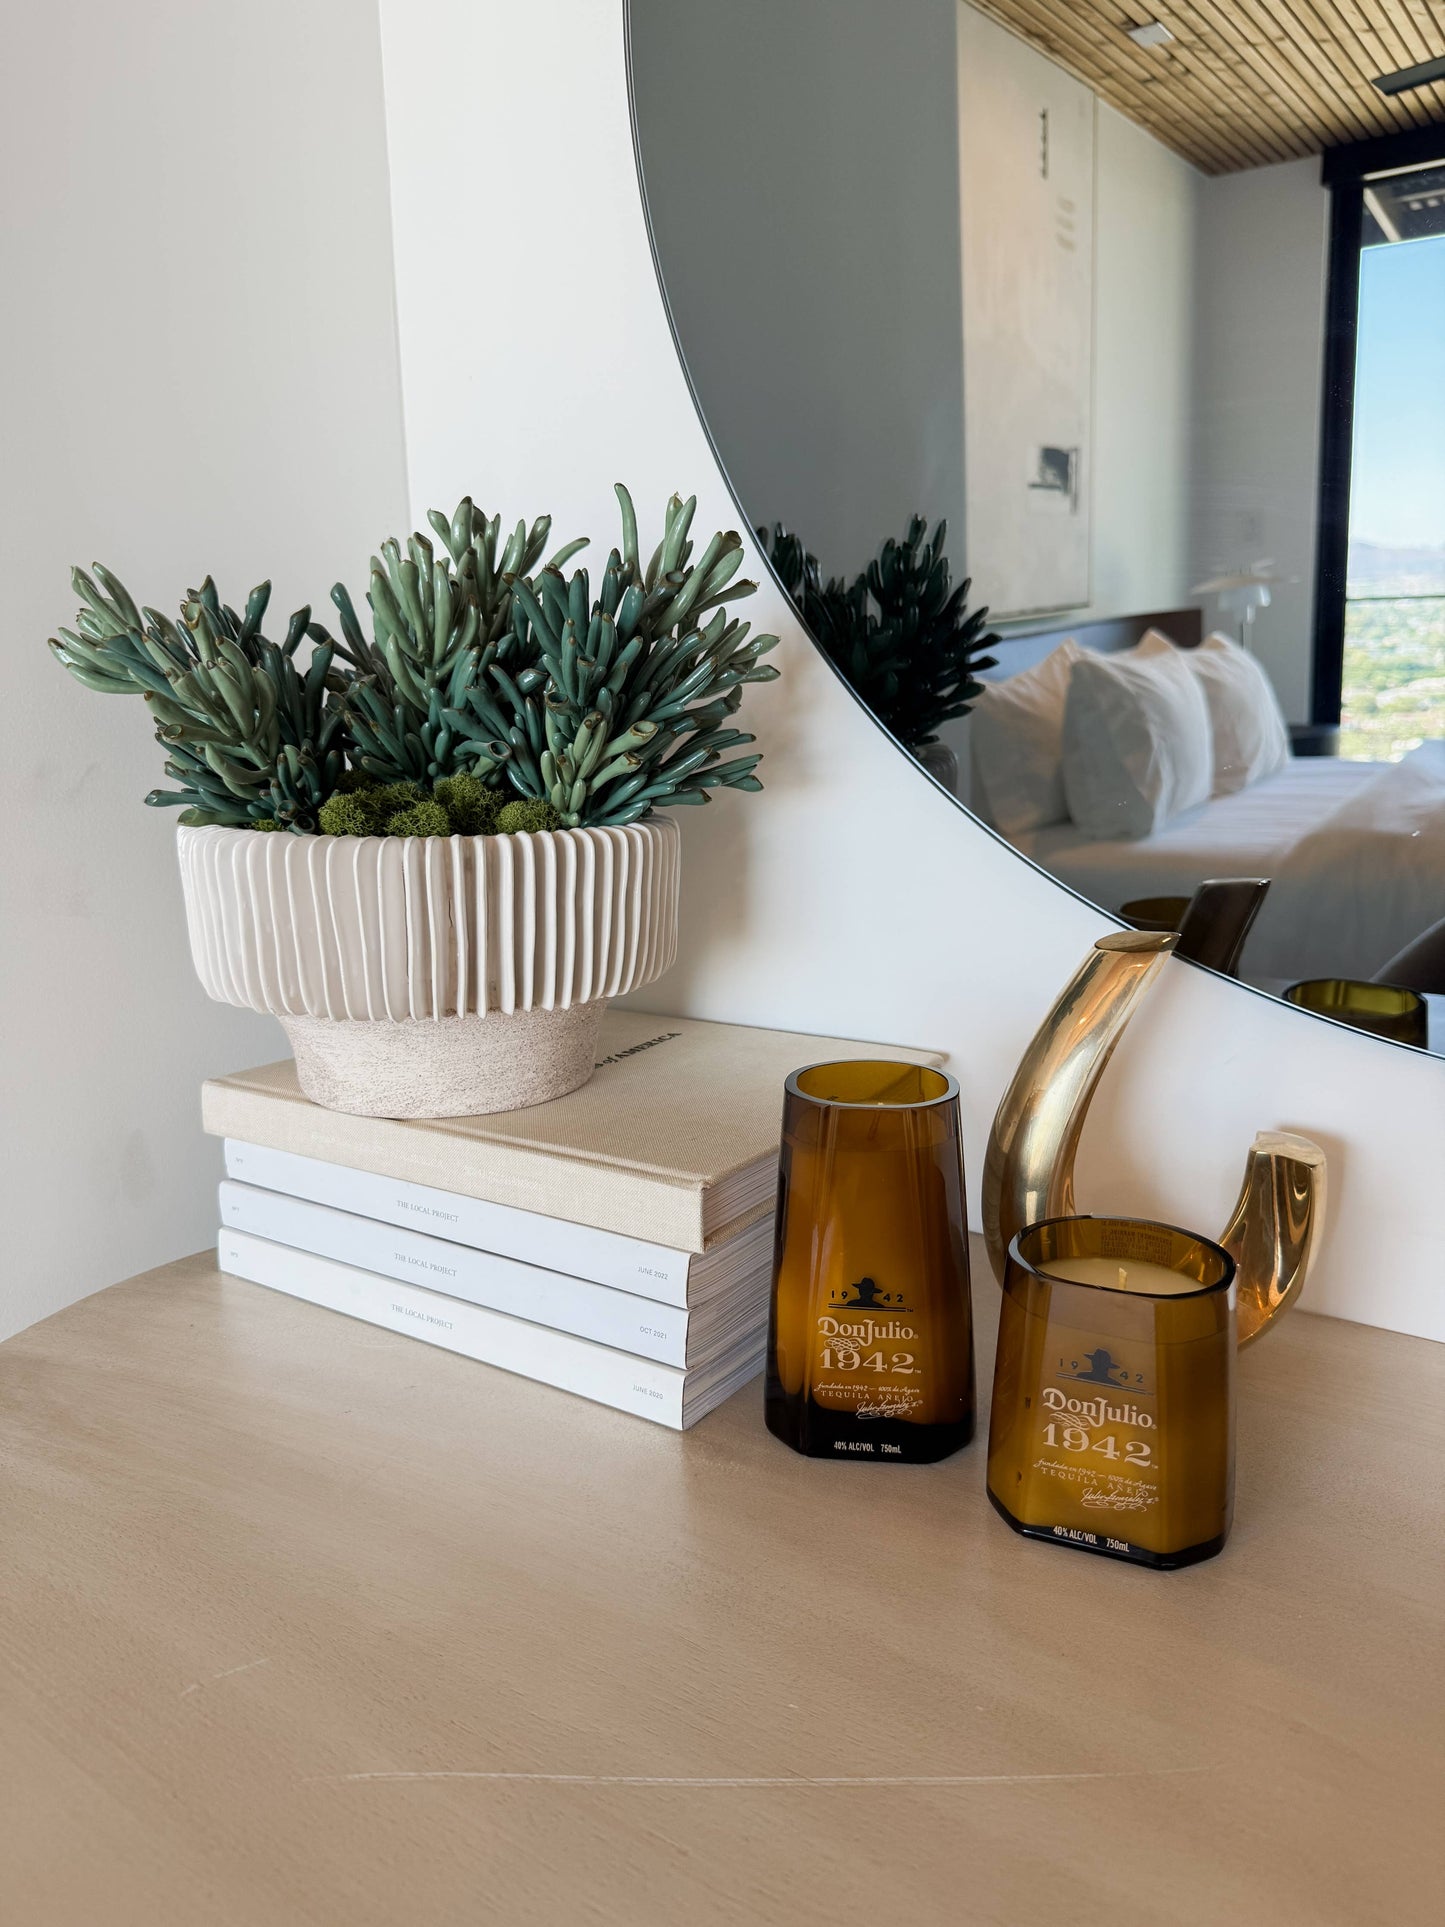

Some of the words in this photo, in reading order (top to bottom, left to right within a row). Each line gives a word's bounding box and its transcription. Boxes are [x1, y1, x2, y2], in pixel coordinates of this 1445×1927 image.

[397, 1200, 409, 1209] THE
[410, 1203, 430, 1216] LOCAL
[431, 1209, 459, 1222] PROJECT
[394, 1252, 406, 1262] THE
[408, 1257, 428, 1269] LOCAL
[430, 1263, 457, 1277] PROJECT
[637, 1266, 653, 1276] JUNE
[654, 1270, 669, 1281] 2022
[391, 1304, 404, 1314] THE
[405, 1309, 425, 1321] LOCAL
[426, 1315, 453, 1330] PROJECT
[639, 1326, 652, 1335] OCT
[653, 1330, 667, 1340] 2021
[820, 1348, 915, 1374] 1942
[633, 1384, 648, 1395] JUNE
[649, 1389, 664, 1400] 2020
[820, 1390, 870, 1400] TEQUILA
[834, 1441, 847, 1451] 40%
[848, 1442, 875, 1452] ALC/VOL
[1042, 1423, 1152, 1467] 1942
[1041, 1467, 1098, 1486] TEQUILA
[1053, 1526, 1068, 1537] 40%
[1069, 1529, 1098, 1545] ALC/VOL
[1106, 1538, 1130, 1552] 750mL
